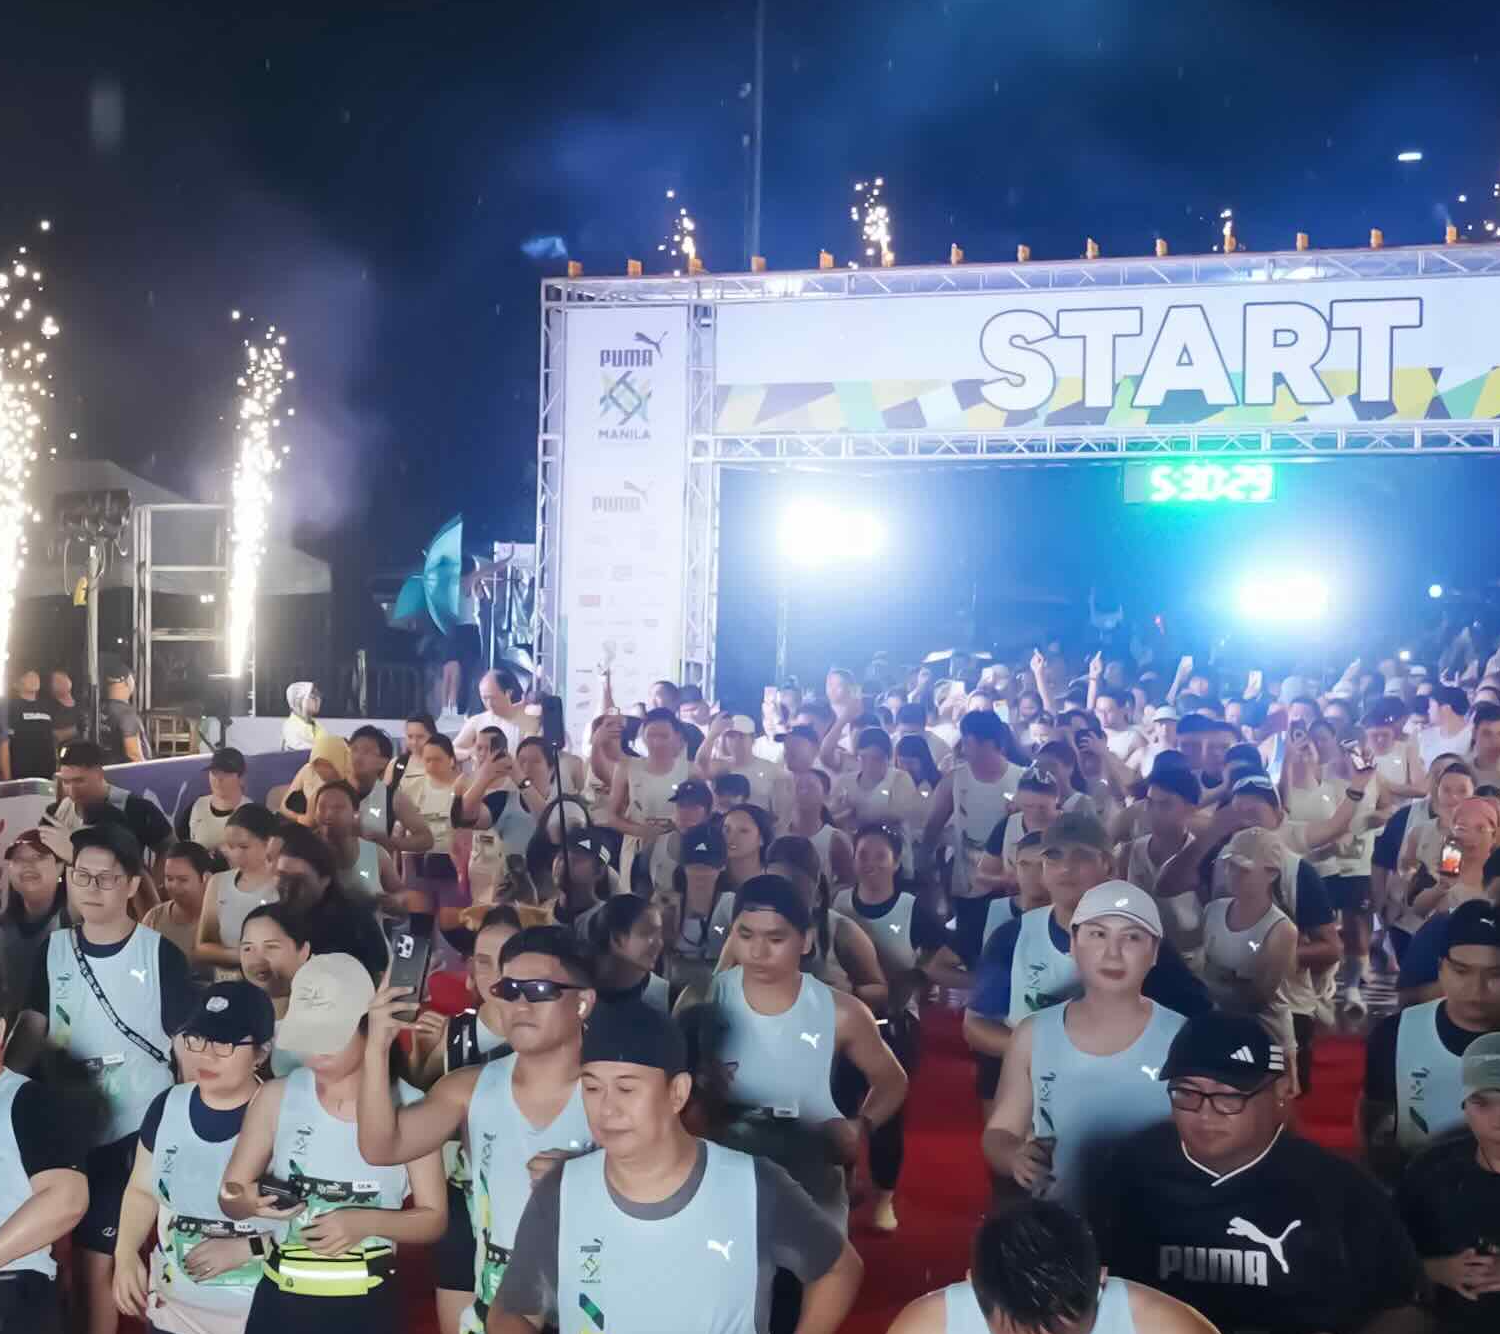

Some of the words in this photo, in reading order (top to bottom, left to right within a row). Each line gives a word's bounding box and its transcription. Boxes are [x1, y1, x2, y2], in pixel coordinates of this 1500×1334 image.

[600, 349, 653, 368] PUMA
[979, 296, 1424, 412] START
[598, 429, 652, 440] MANILA
[1159, 1244, 1268, 1287] PUMA
